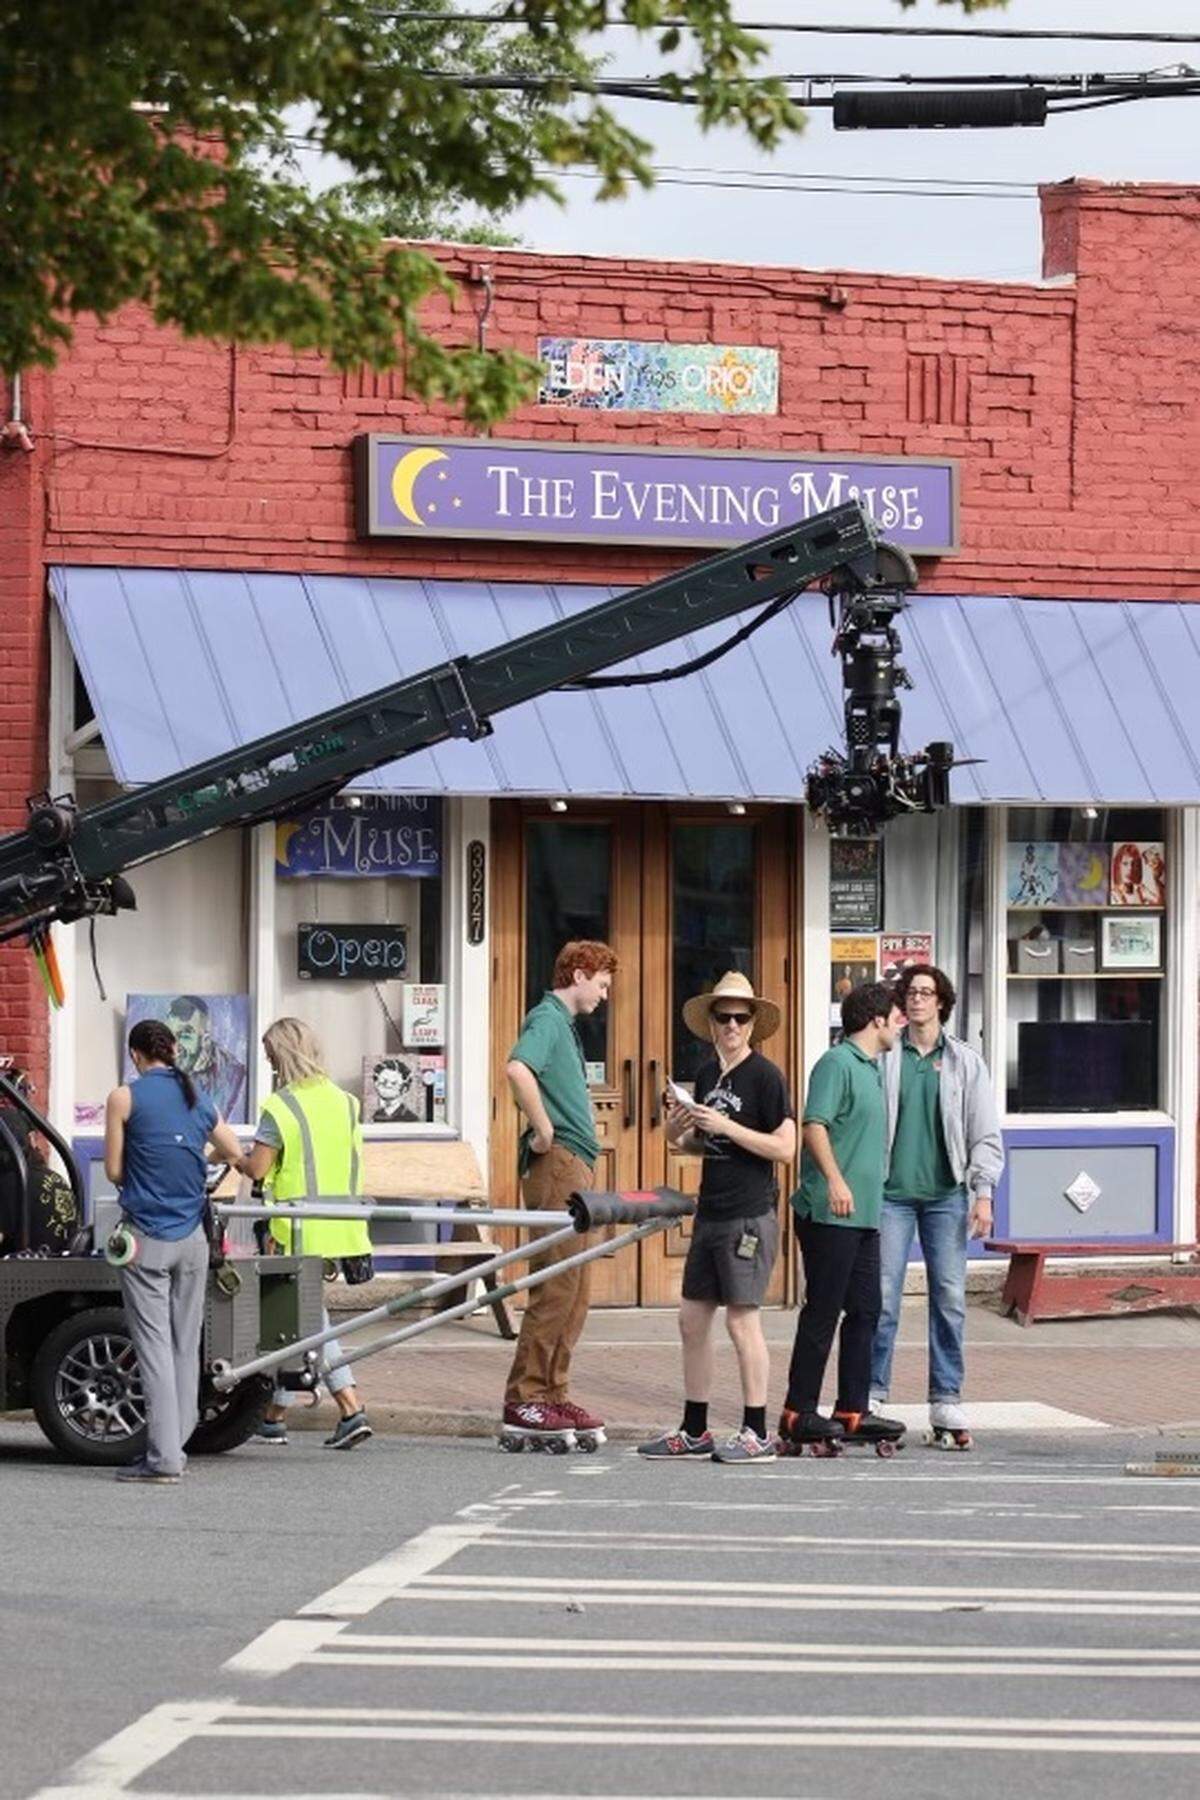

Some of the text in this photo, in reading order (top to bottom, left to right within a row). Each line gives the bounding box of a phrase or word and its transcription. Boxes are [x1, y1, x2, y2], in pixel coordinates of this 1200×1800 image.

[681, 364, 773, 397] ORION
[486, 465, 576, 518] THE
[590, 470, 781, 527] EVENING
[472, 844, 484, 941] 3227
[308, 930, 406, 976] Open
